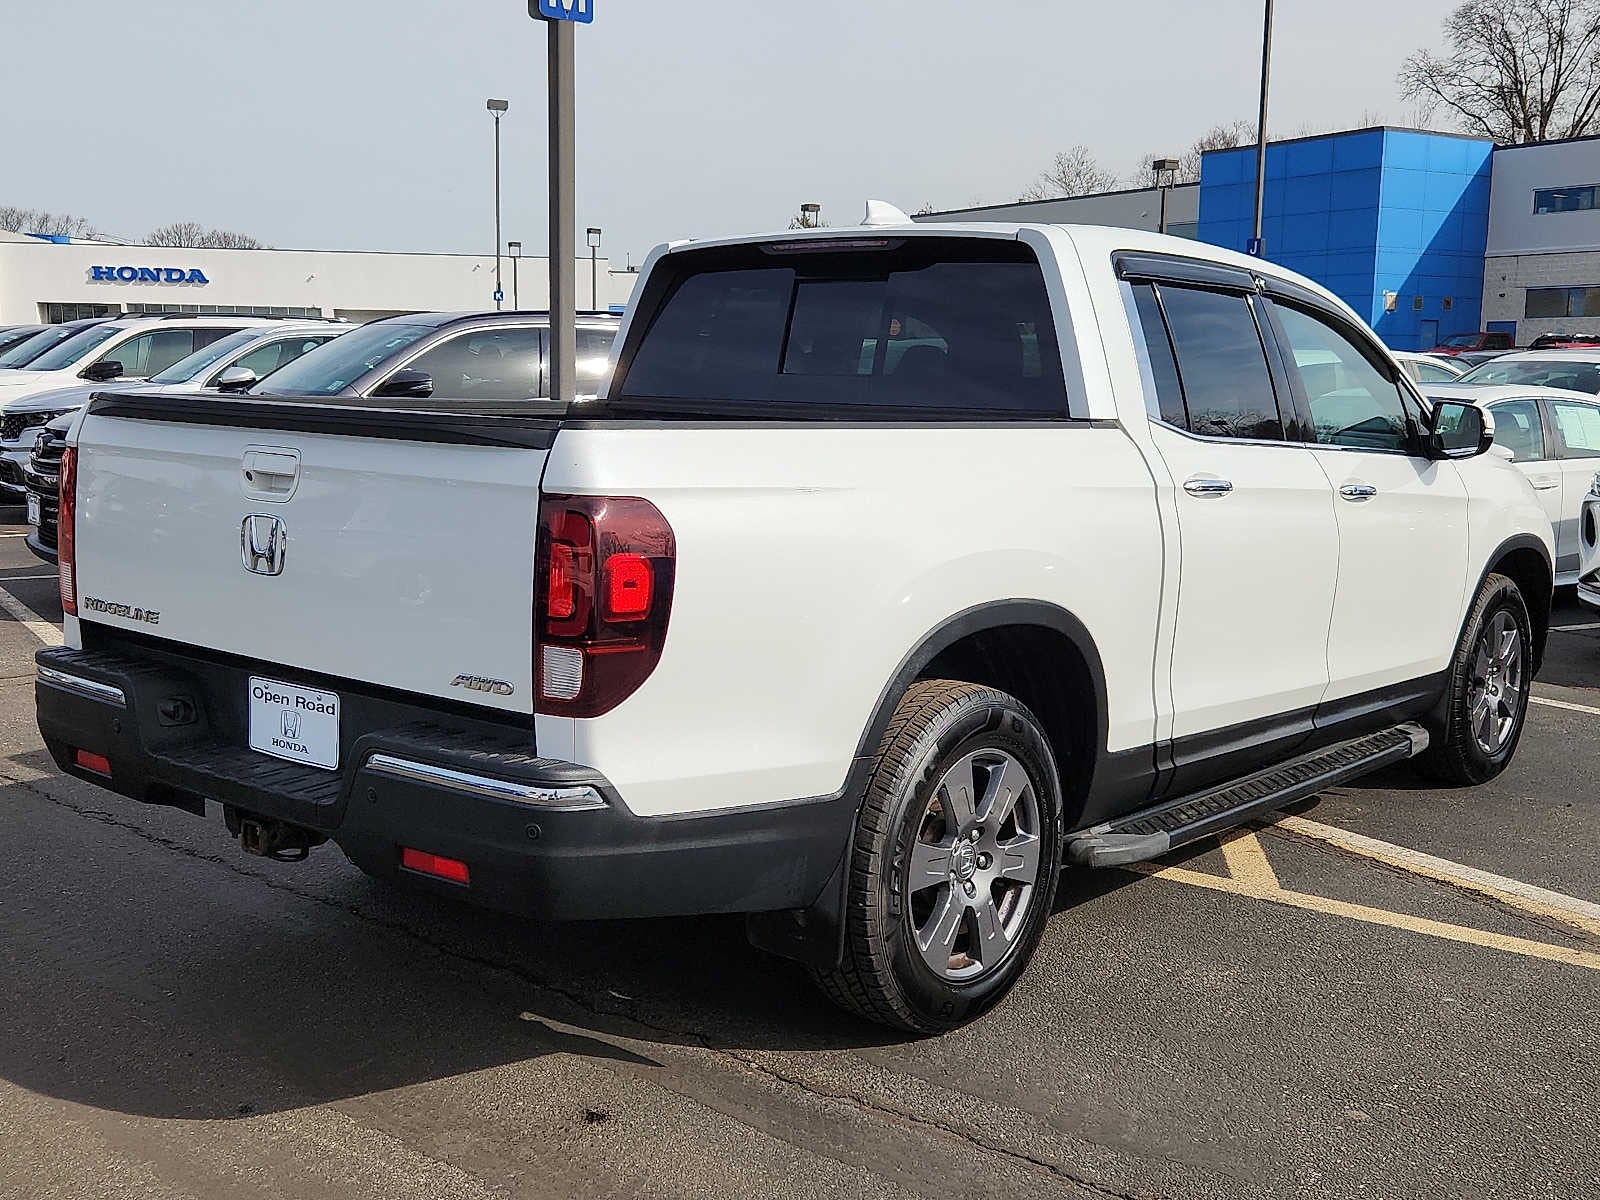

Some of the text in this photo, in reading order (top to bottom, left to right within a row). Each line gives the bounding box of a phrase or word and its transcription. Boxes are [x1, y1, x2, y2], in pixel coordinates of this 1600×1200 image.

[1249, 241, 1257, 254] J
[91, 266, 209, 284] HONDA
[84, 597, 160, 625] RIDGELINE
[450, 675, 515, 696] AWD
[252, 686, 336, 716] Open Road
[271, 737, 310, 755] HONDA
